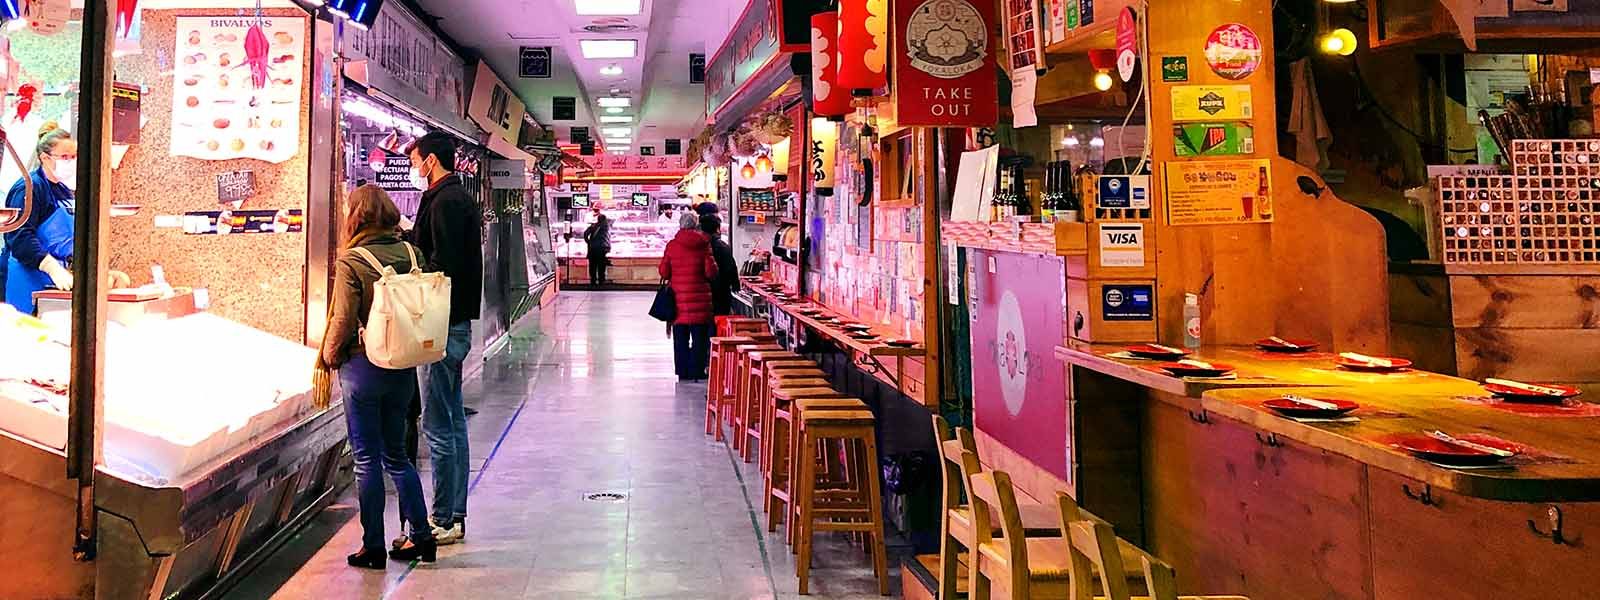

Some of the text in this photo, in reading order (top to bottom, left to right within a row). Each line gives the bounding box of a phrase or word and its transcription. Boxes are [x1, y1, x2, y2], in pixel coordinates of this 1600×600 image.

[923, 87, 972, 99] TAKE
[931, 104, 971, 116] OUT
[1107, 233, 1138, 244] VISA
